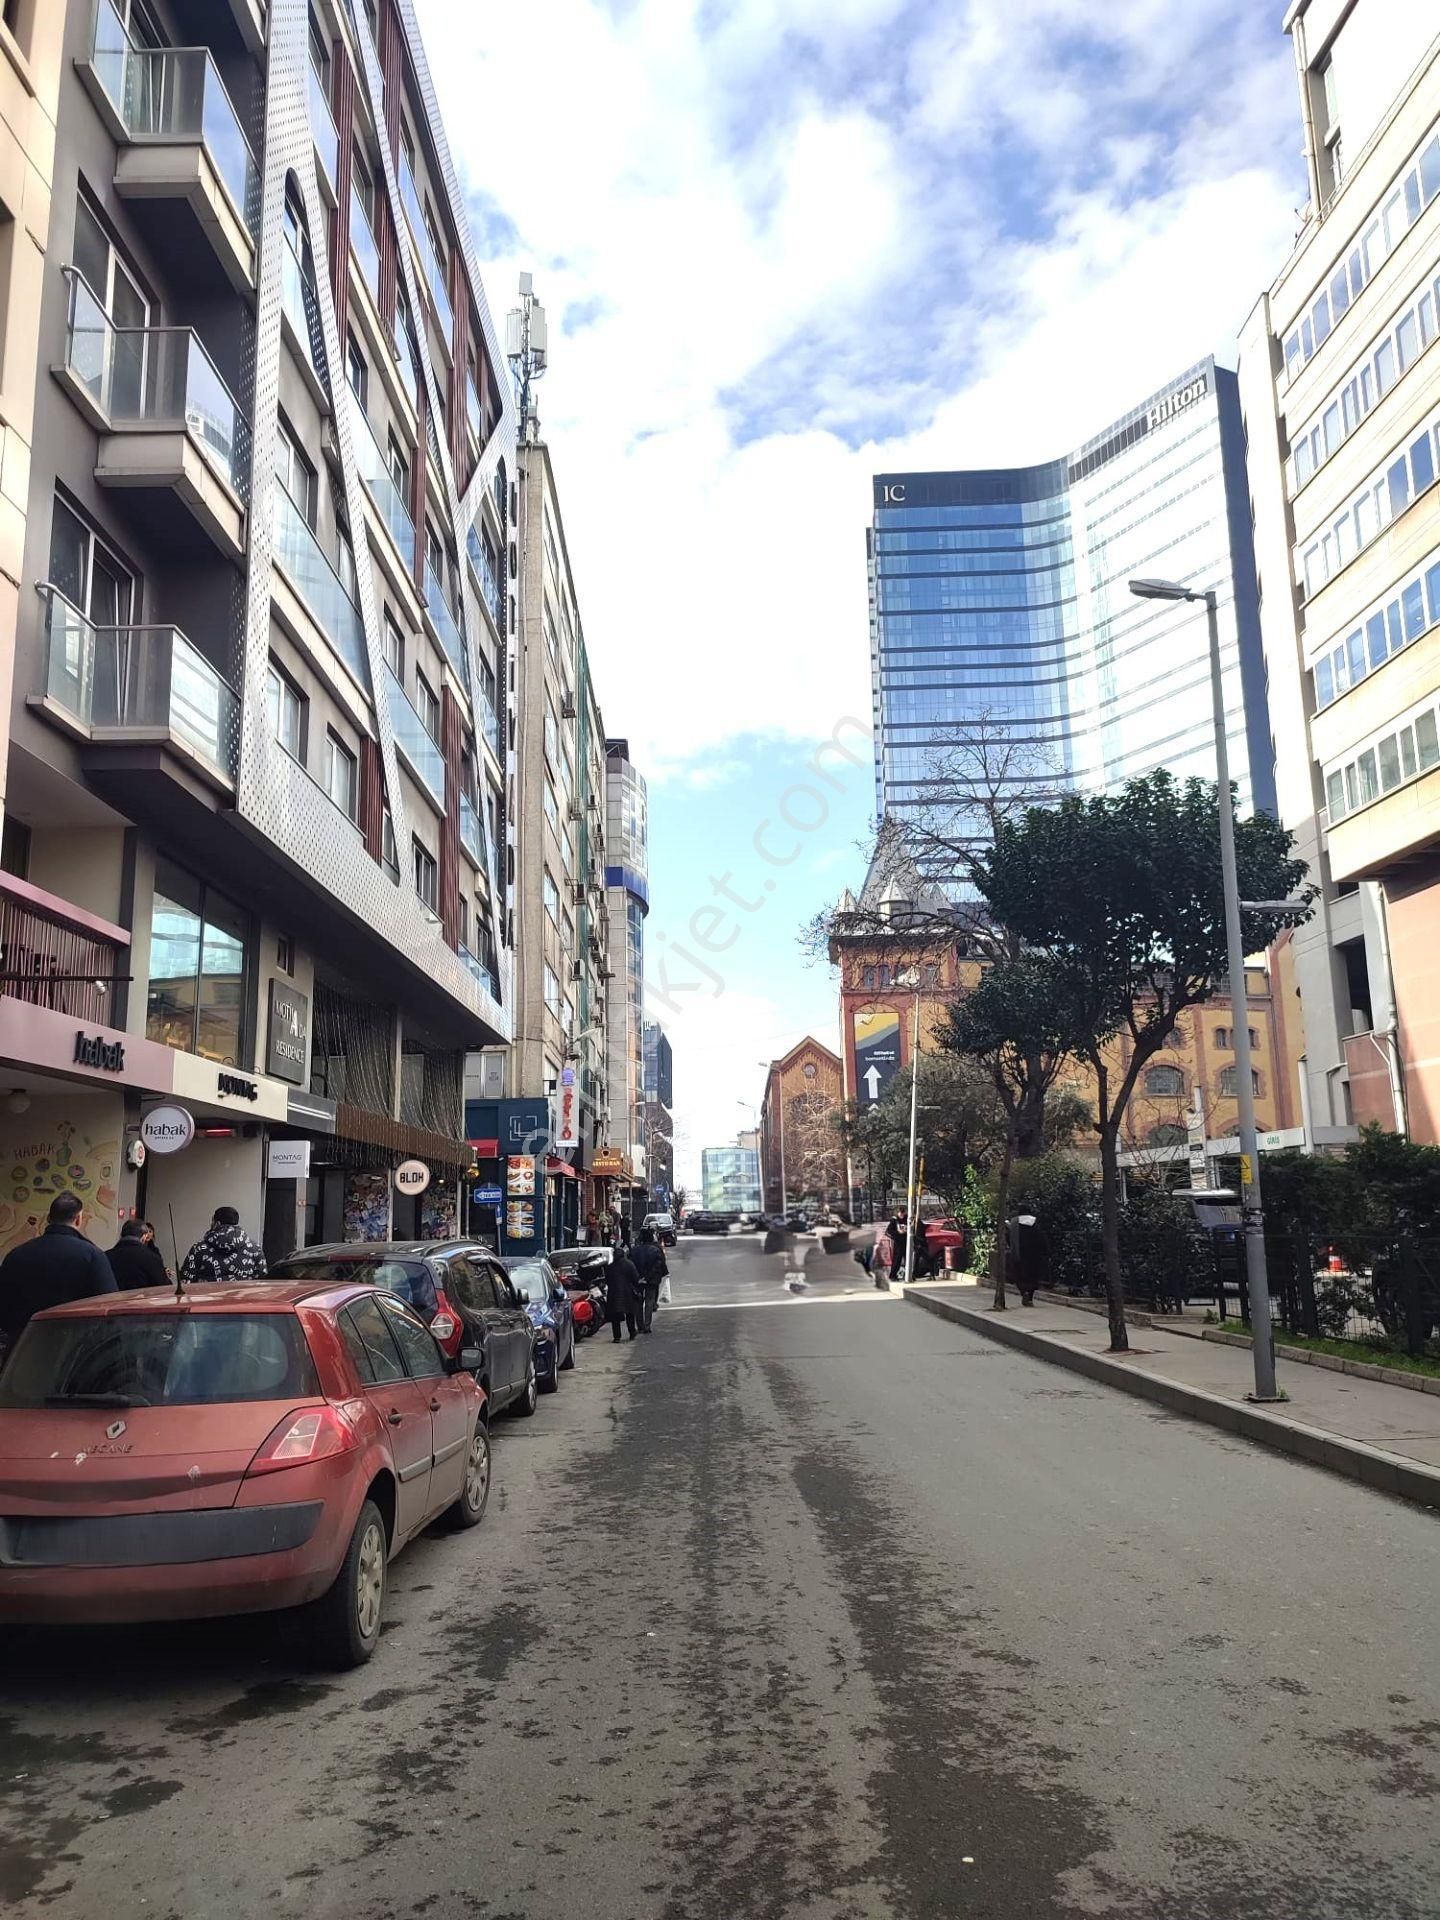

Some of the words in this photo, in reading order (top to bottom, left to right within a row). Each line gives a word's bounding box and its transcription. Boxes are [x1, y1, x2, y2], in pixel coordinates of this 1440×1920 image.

[1147, 377, 1206, 431] Hilton
[884, 485, 906, 502] IC
[145, 1124, 186, 1136] habak
[272, 1153, 303, 1161] MONTAG
